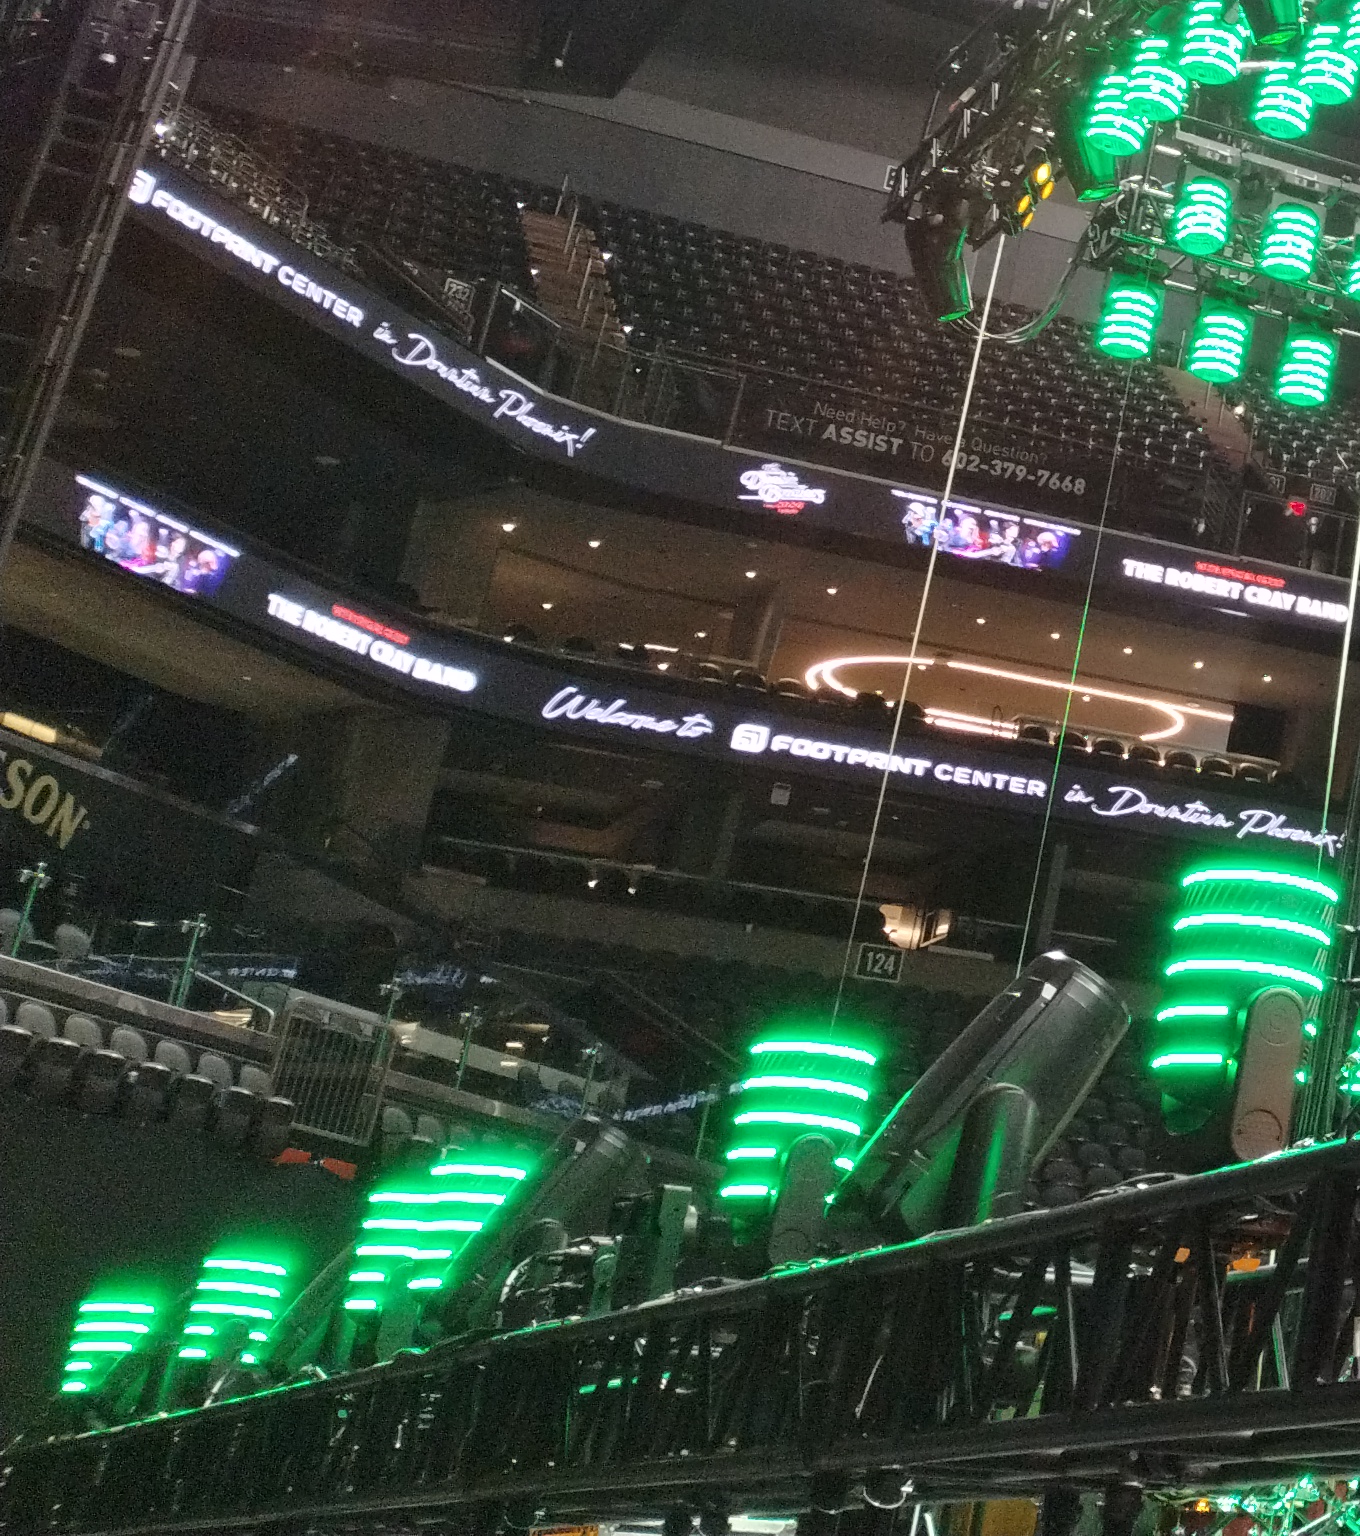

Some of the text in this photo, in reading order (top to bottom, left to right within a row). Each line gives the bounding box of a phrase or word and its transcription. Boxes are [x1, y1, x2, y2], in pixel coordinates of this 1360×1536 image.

[151, 189, 281, 274] FOOTPRINT
[277, 265, 364, 328] CENTER
[765, 409, 1086, 496] TEXT ASSIST TO 602-379-7668
[814, 401, 855, 424] Need
[859, 411, 906, 433] Help?
[915, 425, 952, 444] Have
[970, 437, 1048, 465] Question?
[1122, 558, 1349, 622] THE ROBERT CRAY BAND
[542, 686, 680, 733] Welcome
[676, 713, 714, 738] to
[770, 734, 933, 777] FOOTPRINT
[935, 763, 1047, 798] CENTER
[865, 951, 895, 975] 124
